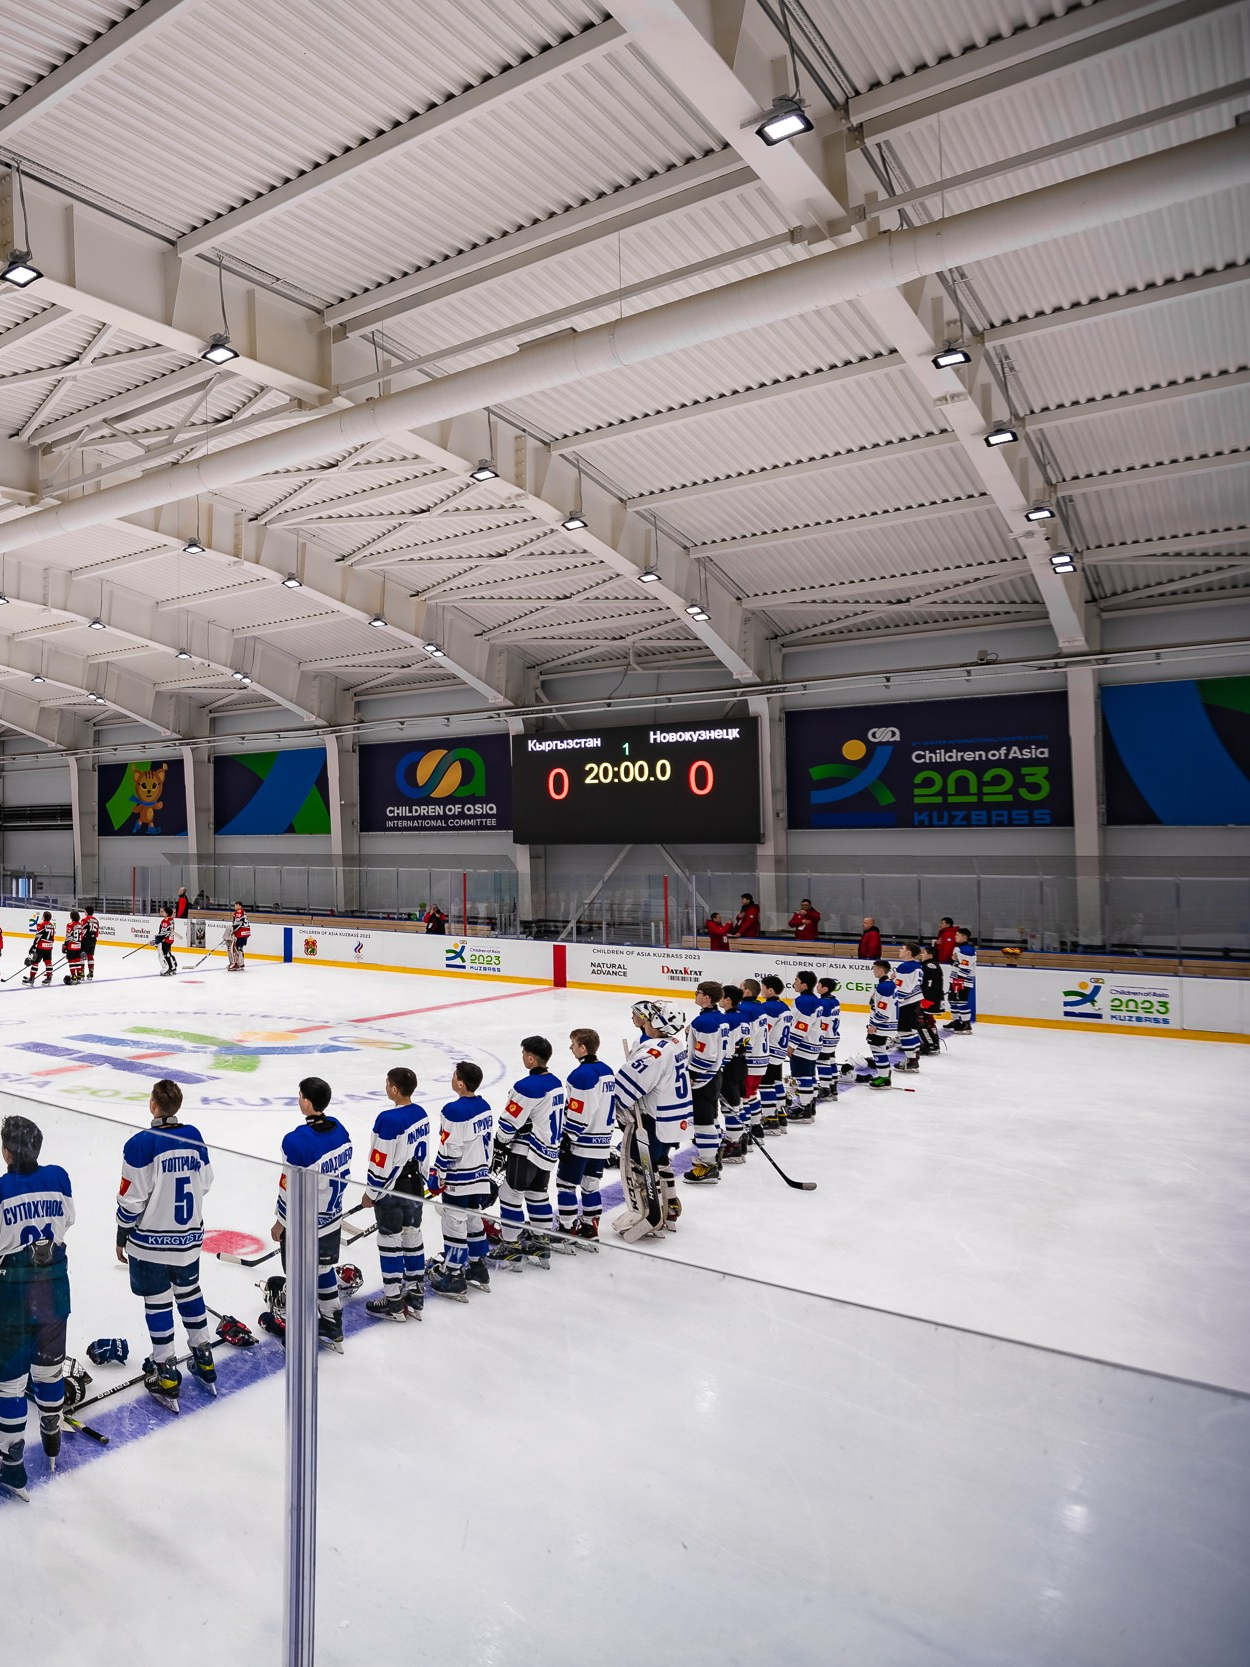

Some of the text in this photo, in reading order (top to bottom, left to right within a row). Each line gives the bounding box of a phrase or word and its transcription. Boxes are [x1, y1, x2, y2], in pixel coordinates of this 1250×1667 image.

[649, 727, 740, 744] Новокузнецк
[528, 736, 601, 752] Кыргызстан
[622, 742, 629, 755] 1
[911, 745, 1049, 763] Children of Asia
[584, 759, 671, 784] 20:00.0
[688, 760, 714, 795] 0
[548, 767, 569, 800] 0
[913, 766, 1050, 803] 2023
[386, 805, 443, 817] CHILDREN
[445, 804, 462, 815] OF
[913, 809, 1051, 825] KUZBASS
[386, 818, 497, 828] INTERNATIONAL COMMITTEE
[470, 954, 501, 966] 2023
[592, 948, 624, 956] CHILDREN
[652, 952, 683, 960] KUZBASS
[590, 962, 627, 970] NATURAL
[775, 959, 814, 968] CHILDREN
[590, 969, 628, 977] ADVANCE
[845, 981, 877, 992] СБЕ
[1110, 998, 1170, 1015] 2023
[1110, 1015, 1170, 1024] KUZBASS
[631, 1058, 649, 1074] 51
[58, 1085, 152, 1101] 202
[173, 1176, 194, 1226] 5
[625, 1176, 640, 1211] CCM
